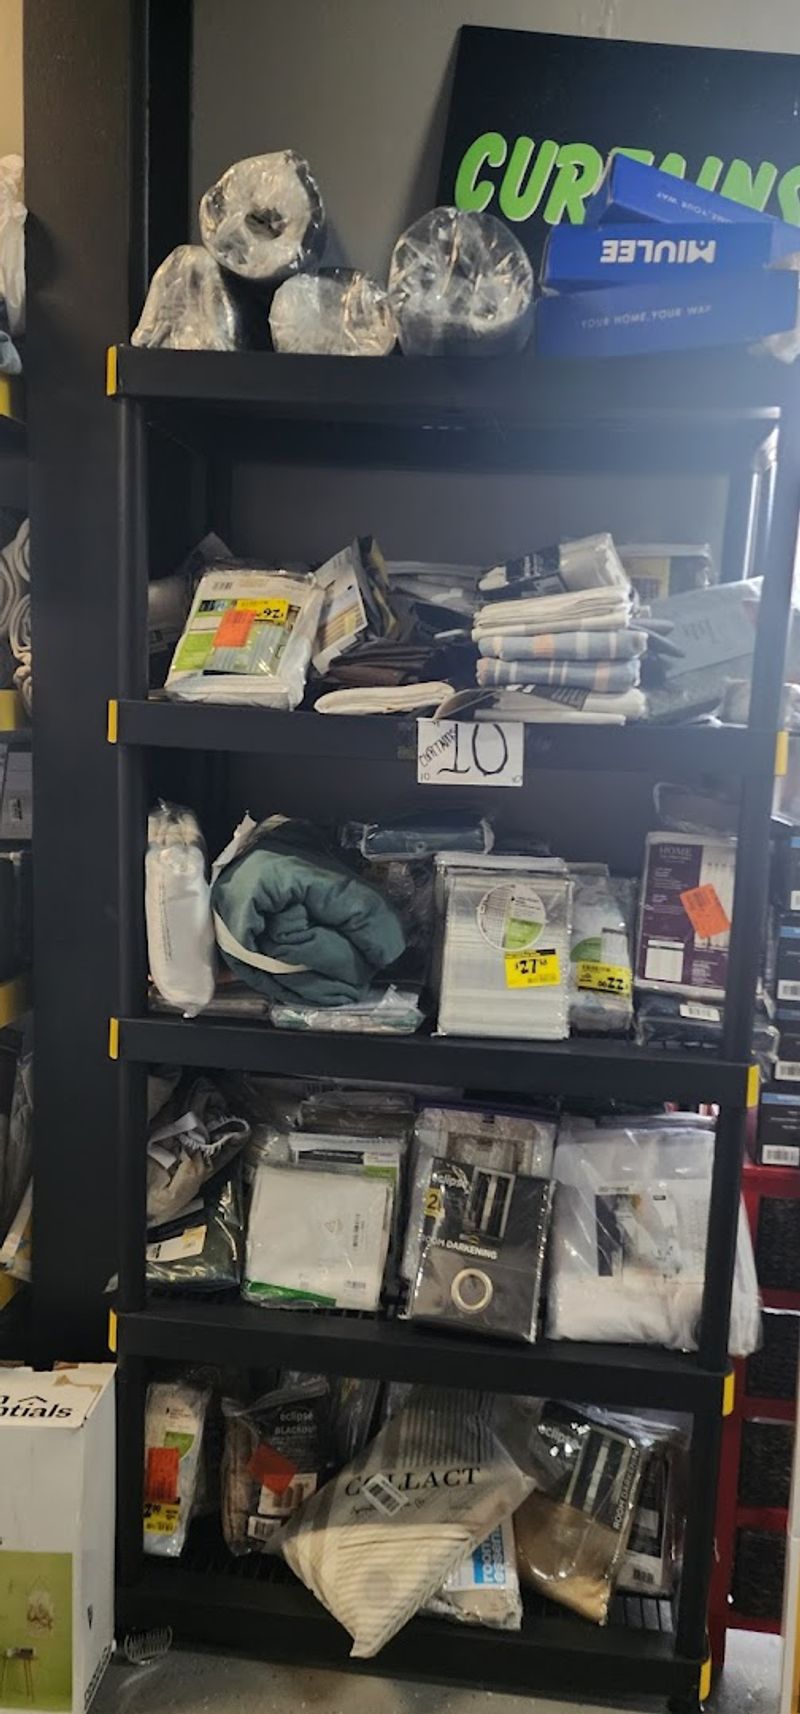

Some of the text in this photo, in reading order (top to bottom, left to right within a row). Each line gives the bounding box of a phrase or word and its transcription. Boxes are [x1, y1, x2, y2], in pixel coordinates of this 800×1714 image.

[600, 239, 717, 263] MIULEE
[582, 317, 609, 328] YOUR
[687, 304, 712, 315] WAY
[436, 723, 508, 776] 10
[446, 1240, 498, 1260] DARKENING
